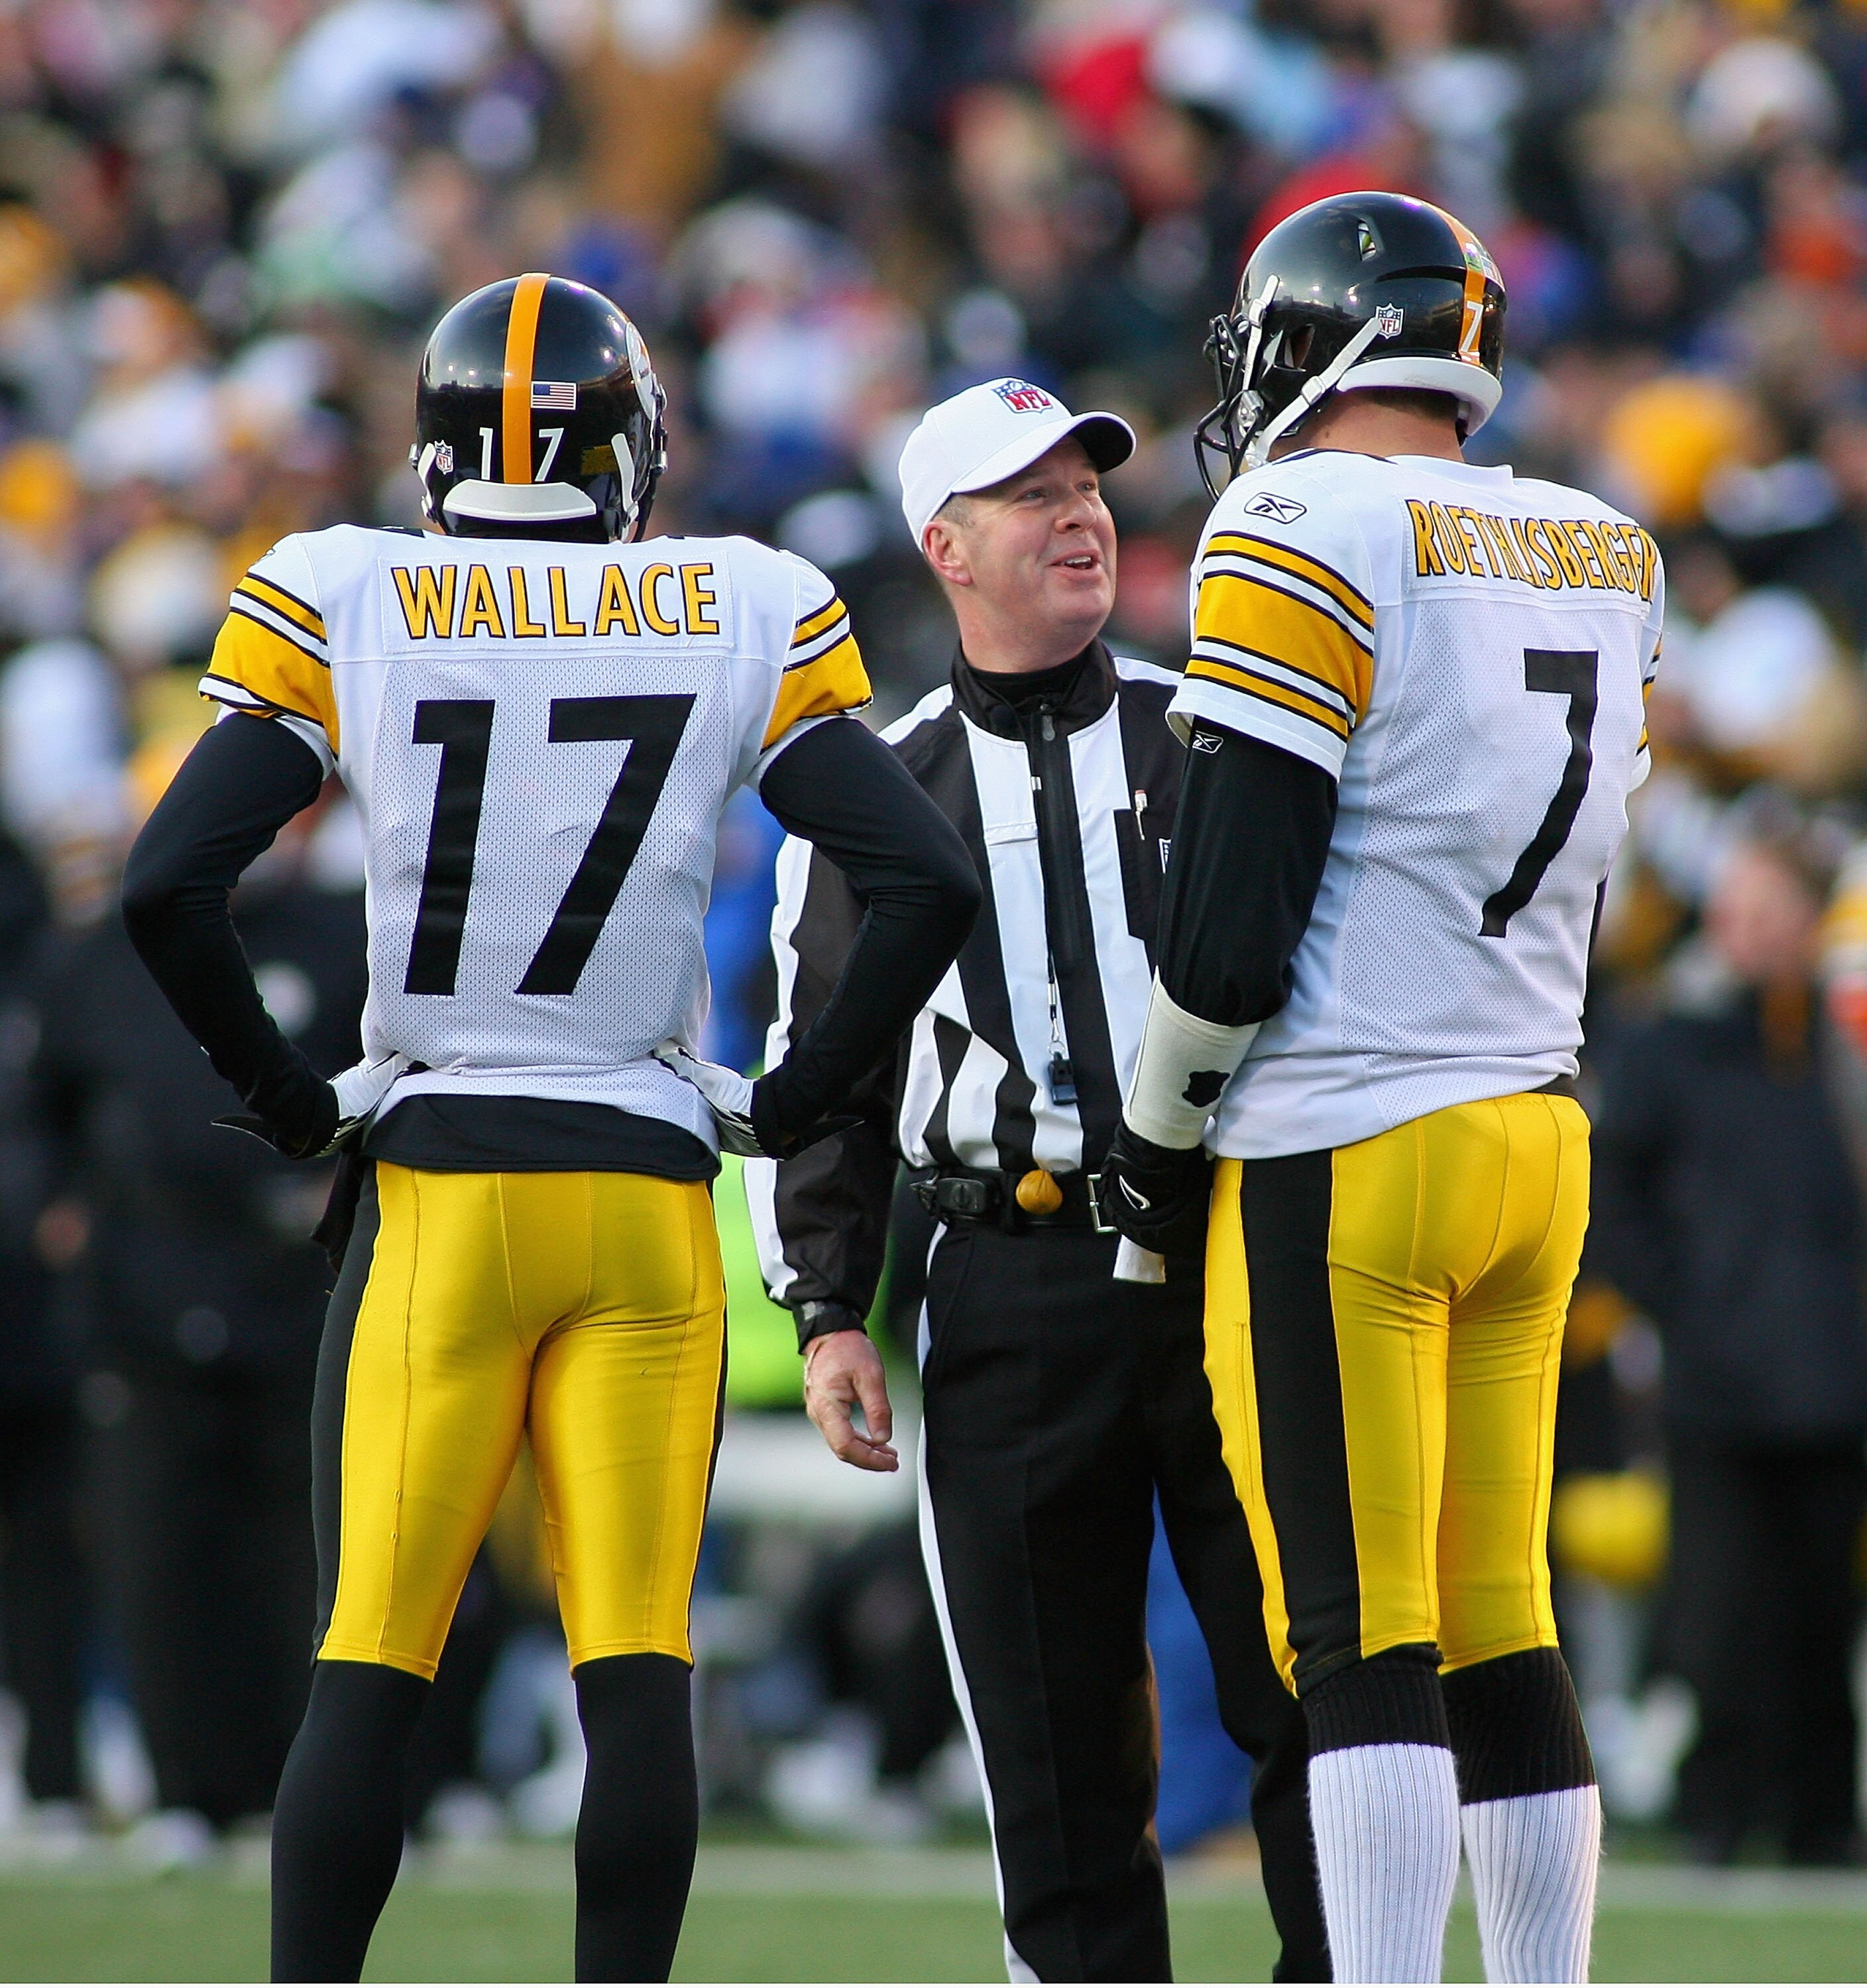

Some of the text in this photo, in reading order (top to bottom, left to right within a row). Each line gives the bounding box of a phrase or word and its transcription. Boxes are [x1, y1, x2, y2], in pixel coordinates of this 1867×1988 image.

[1379, 318, 1400, 333] NFL
[1460, 300, 1484, 352] 7
[1005, 390, 1050, 410] NFL
[438, 455, 452, 469] NFL
[1405, 499, 1656, 604] ROETHLISBERGER
[391, 563, 720, 639] WALLACE
[1478, 647, 1599, 938] 7
[403, 693, 698, 997] 17
